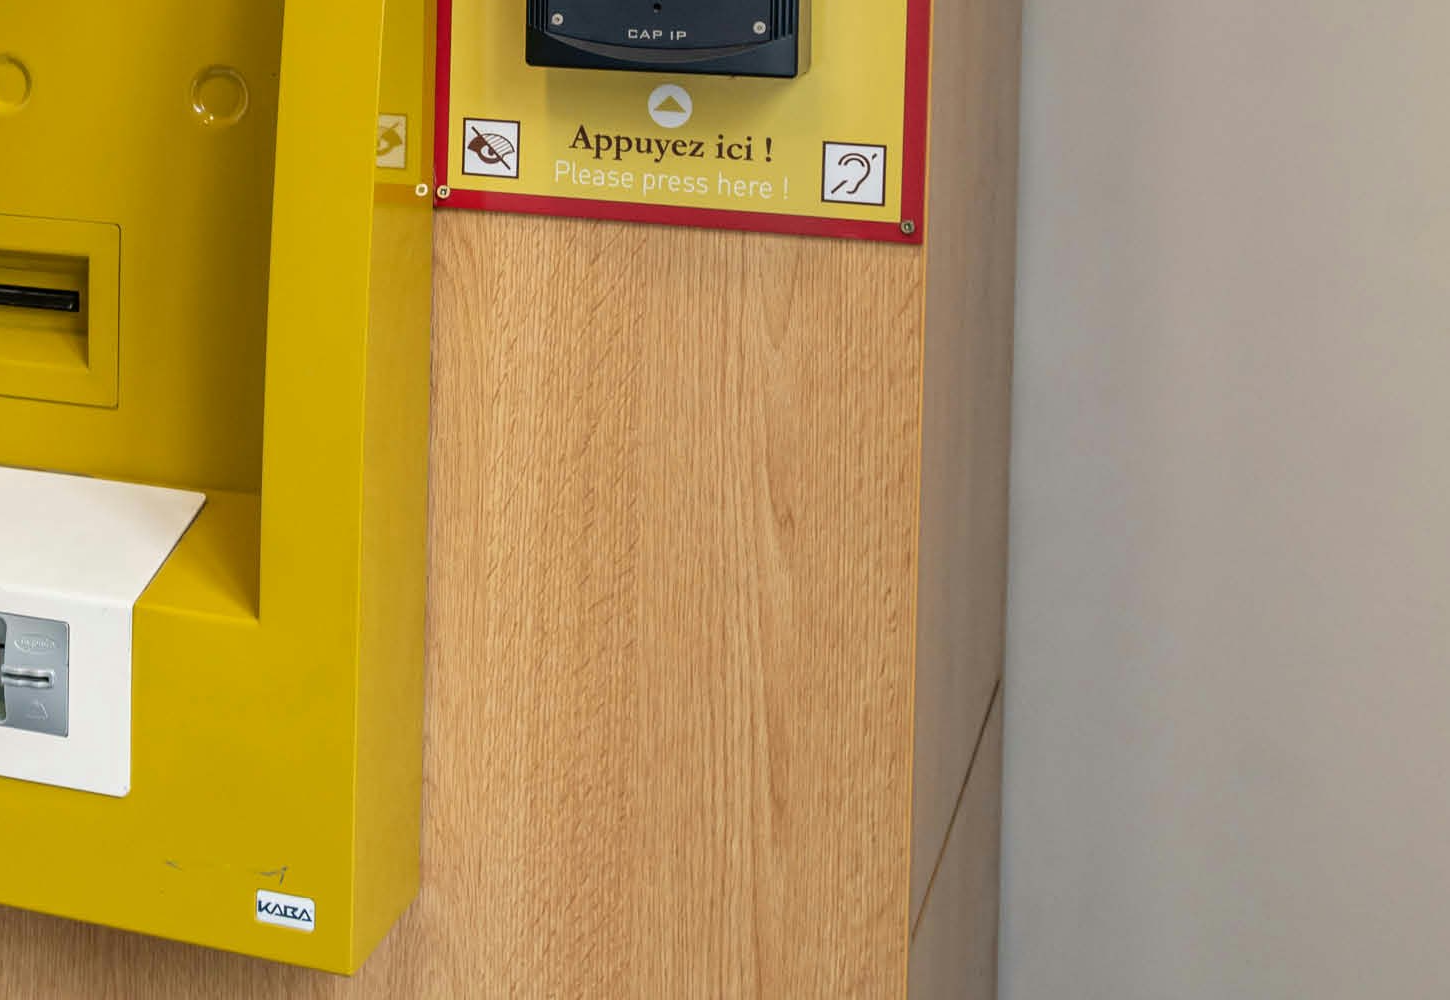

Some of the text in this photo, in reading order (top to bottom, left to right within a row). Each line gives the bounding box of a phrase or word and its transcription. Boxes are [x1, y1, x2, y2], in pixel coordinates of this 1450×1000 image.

[627, 28, 688, 41] CAP IP
[568, 125, 704, 162] Appuyez
[715, 134, 752, 160] ici
[554, 161, 633, 188] Please
[641, 173, 709, 195] press
[717, 172, 772, 198] here
[257, 900, 313, 922] KABA
